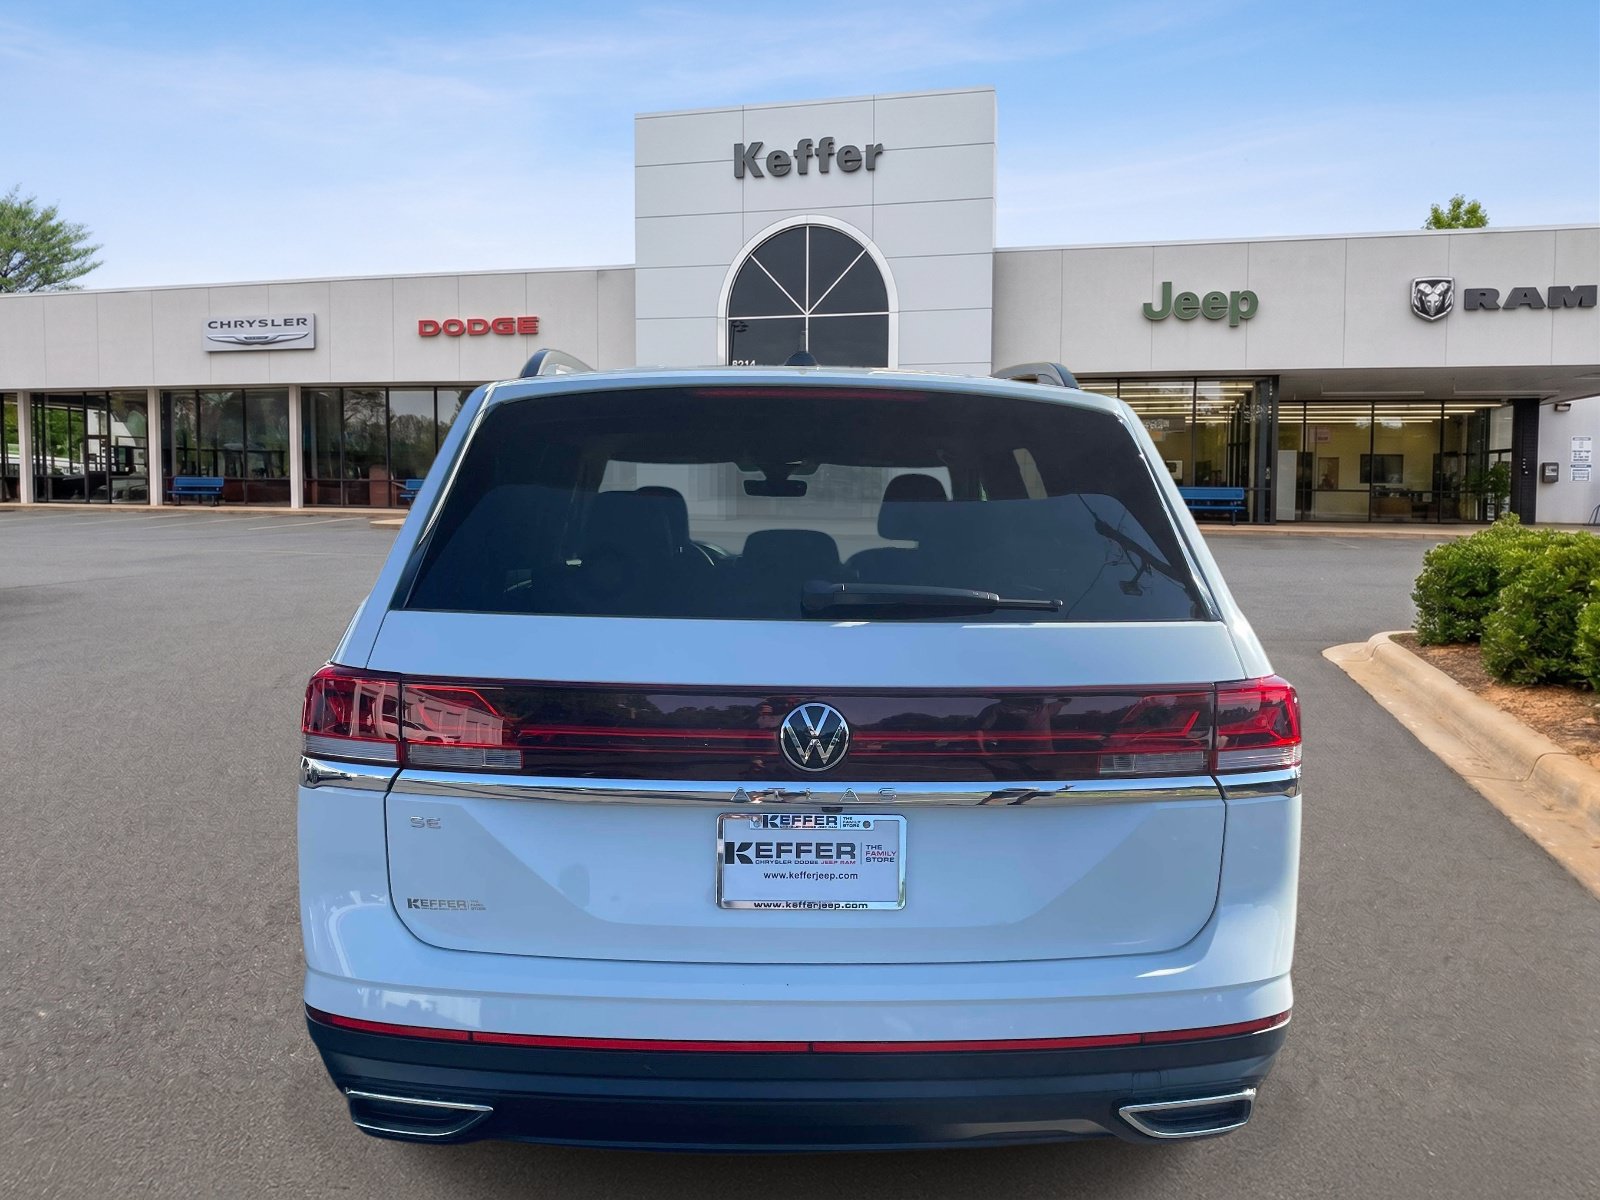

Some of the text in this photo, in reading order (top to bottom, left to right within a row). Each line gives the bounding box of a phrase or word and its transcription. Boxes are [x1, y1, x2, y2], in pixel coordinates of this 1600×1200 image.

[733, 136, 884, 179] Keffer
[1142, 281, 1259, 328] Jeep
[1463, 285, 1598, 311] RAM
[207, 317, 308, 330] CHRYSLER
[418, 316, 539, 338] DODGE
[732, 359, 756, 367] 8214
[731, 786, 897, 803] ATLAS
[409, 815, 442, 830] SE
[763, 814, 838, 829] KEFFER
[725, 842, 856, 864] KEFFER
[763, 871, 859, 881] www.kefferjeep.com
[407, 898, 467, 909] KEFFER
[753, 900, 868, 910] www.kefferjeep.com
